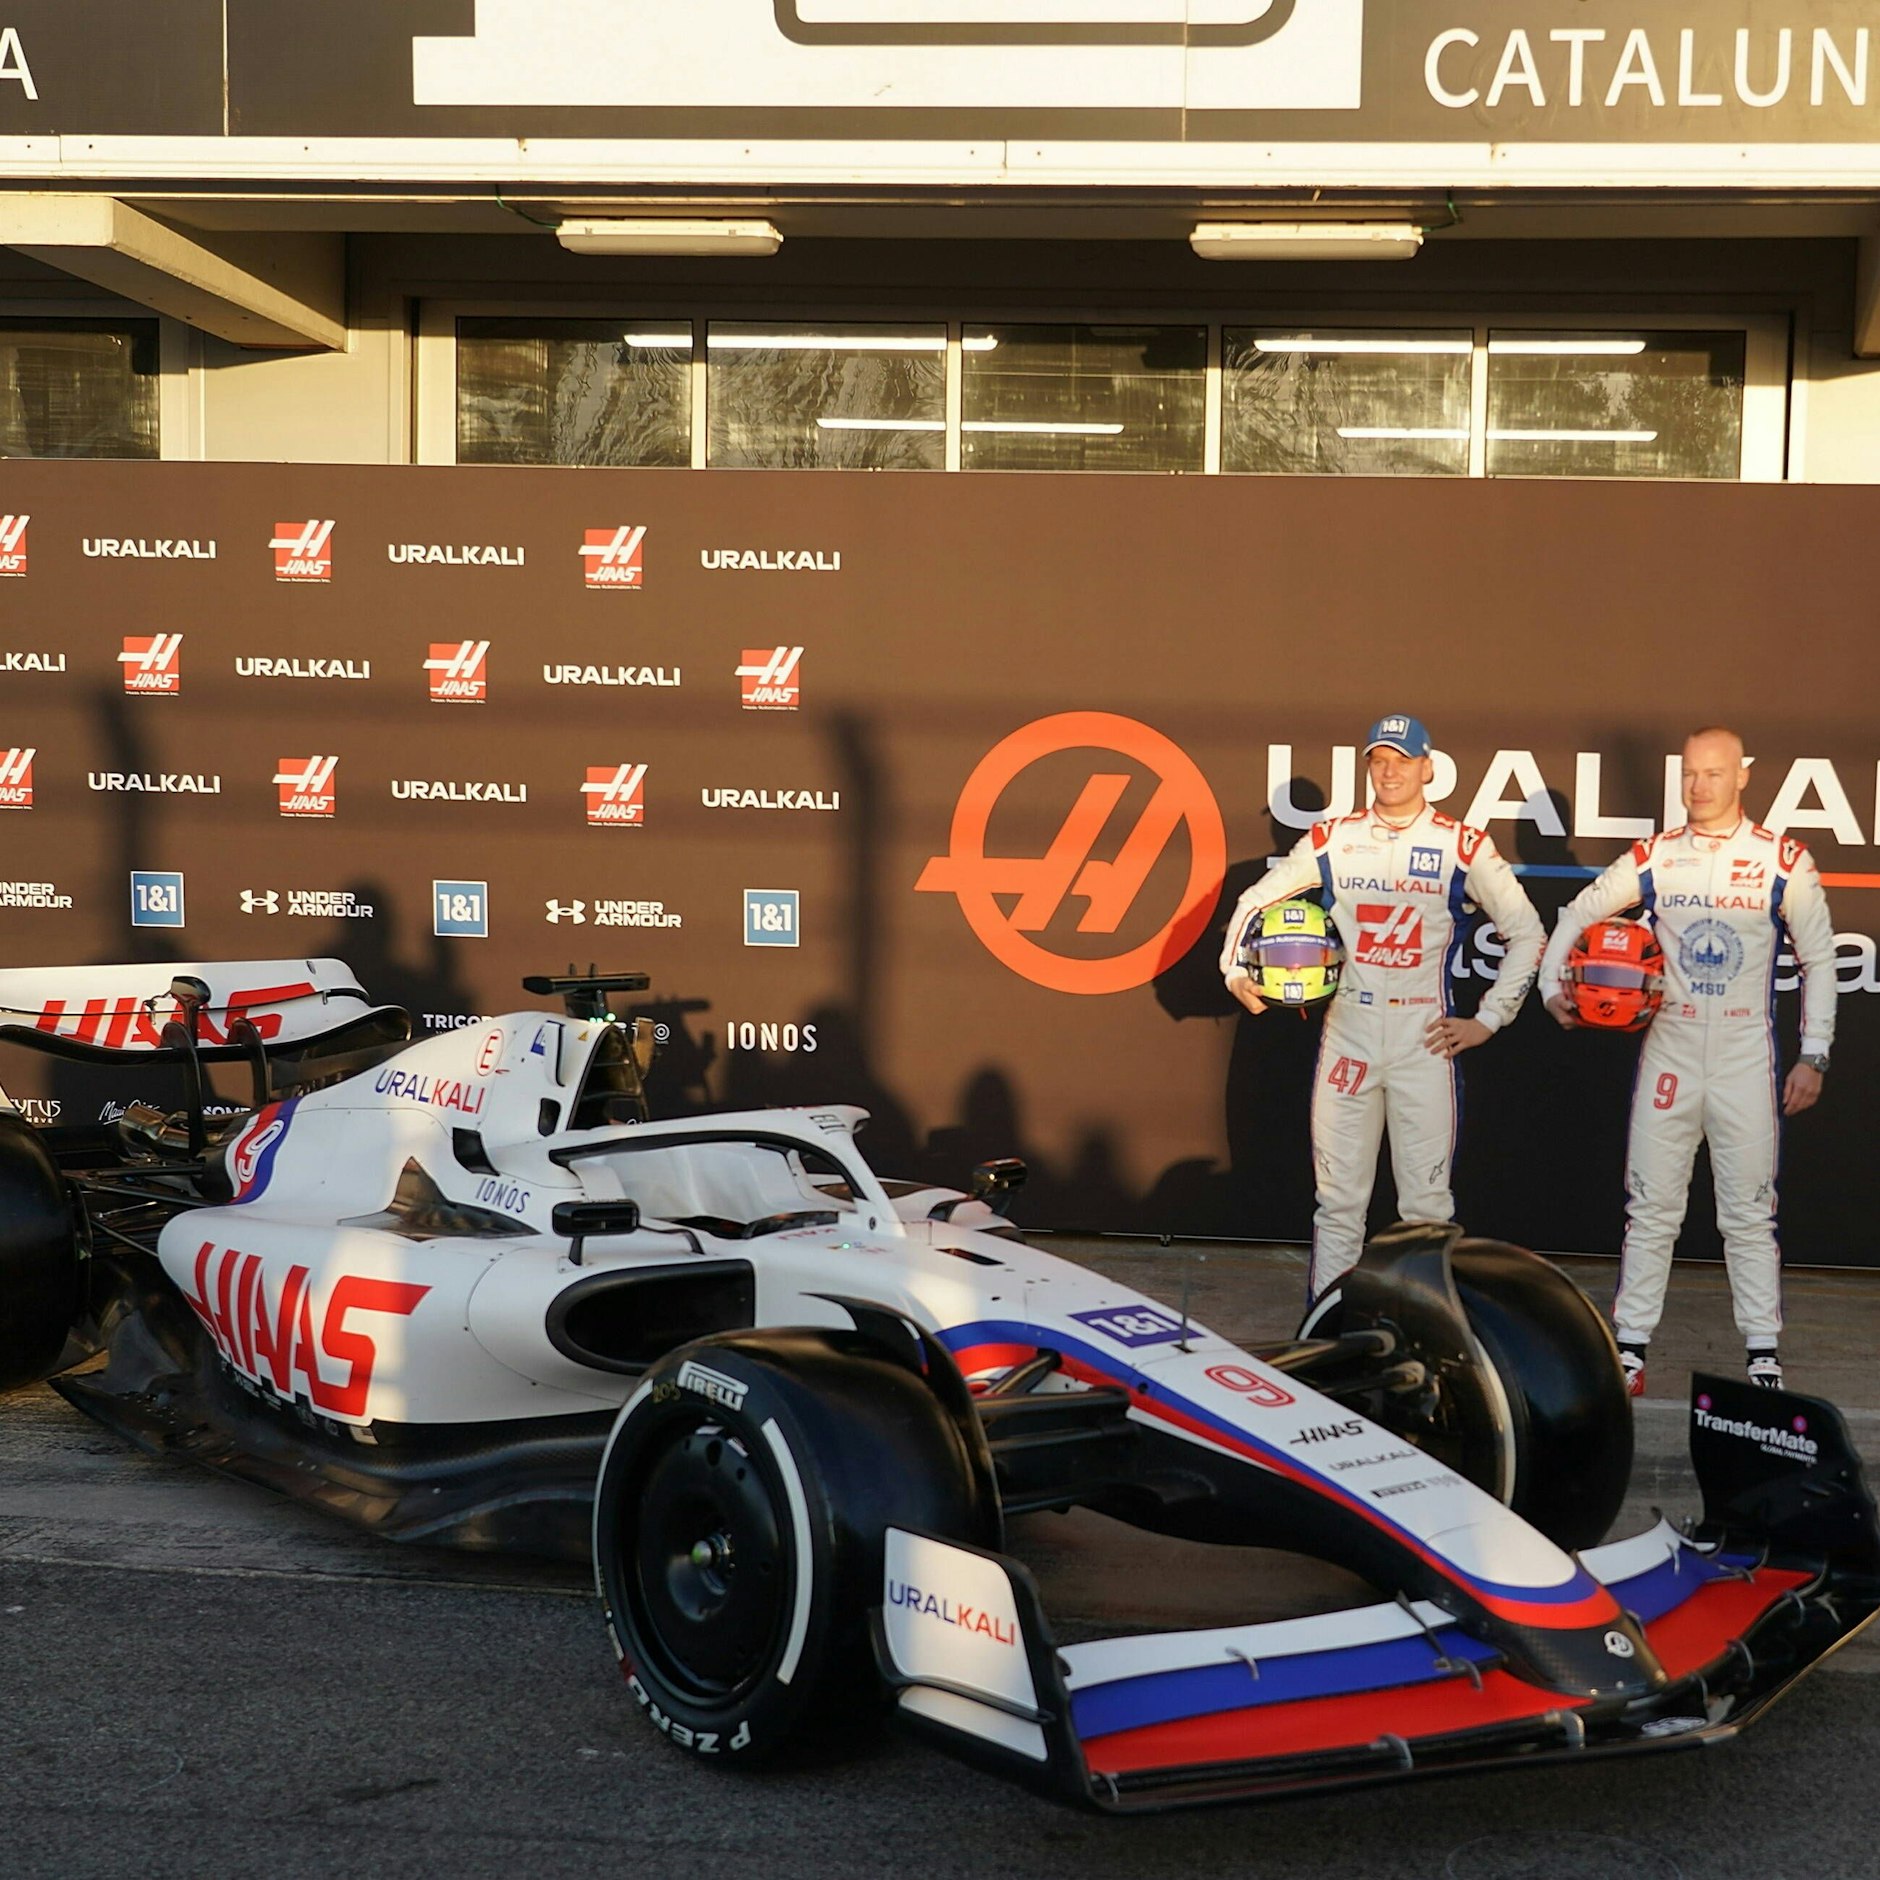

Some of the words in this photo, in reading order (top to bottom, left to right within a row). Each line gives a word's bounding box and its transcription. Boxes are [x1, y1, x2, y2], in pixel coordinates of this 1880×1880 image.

[1425, 28, 1868, 107] CATALUN
[83, 538, 216, 559] URALKALI
[388, 544, 525, 565] URALKALI
[275, 559, 332, 575] HAAS
[701, 549, 841, 571] URALKALI
[585, 566, 643, 582] HAAS
[235, 657, 370, 679] URALKALI
[543, 664, 681, 686] URALKALI
[124, 673, 180, 689] HAAS
[430, 680, 487, 696] HAAS
[742, 687, 800, 703] HAAS
[1382, 719, 1406, 733] 1&1
[88, 772, 221, 794] URALKALI
[391, 780, 527, 803] URALKALI
[279, 795, 336, 810] HAAS
[701, 788, 840, 810] URALKALI
[587, 803, 644, 819] HAAS
[1411, 851, 1441, 872] 1&1
[287, 890, 356, 905] UNDER
[1338, 877, 1444, 896] URALKALI
[136, 884, 178, 912] 1&1
[438, 893, 481, 922] 1&1
[594, 900, 664, 915] UNDER
[1661, 894, 1765, 911] URALKALI
[287, 903, 374, 918] ARMOUR
[594, 913, 682, 929] ARMOUR
[749, 903, 793, 932] 1&1
[1355, 946, 1422, 967] HAAS
[1690, 982, 1726, 997] MSU
[727, 1021, 818, 1053] IONOS
[479, 1035, 499, 1070] E
[1328, 1056, 1368, 1096] 47
[375, 1068, 486, 1115] URALKALI
[1653, 1072, 1679, 1110] 9
[475, 1177, 531, 1214] IONOS
[183, 1241, 434, 1418] HAAS
[1088, 1311, 1180, 1338] 1&1
[677, 1360, 750, 1412] PIRELLI
[1204, 1364, 1297, 1408] 9
[1289, 1419, 1364, 1445] HAAS
[1694, 1408, 1819, 1455] TransferMate
[889, 1578, 1017, 1648] URALKALI
[629, 1674, 720, 1754] ZERO
